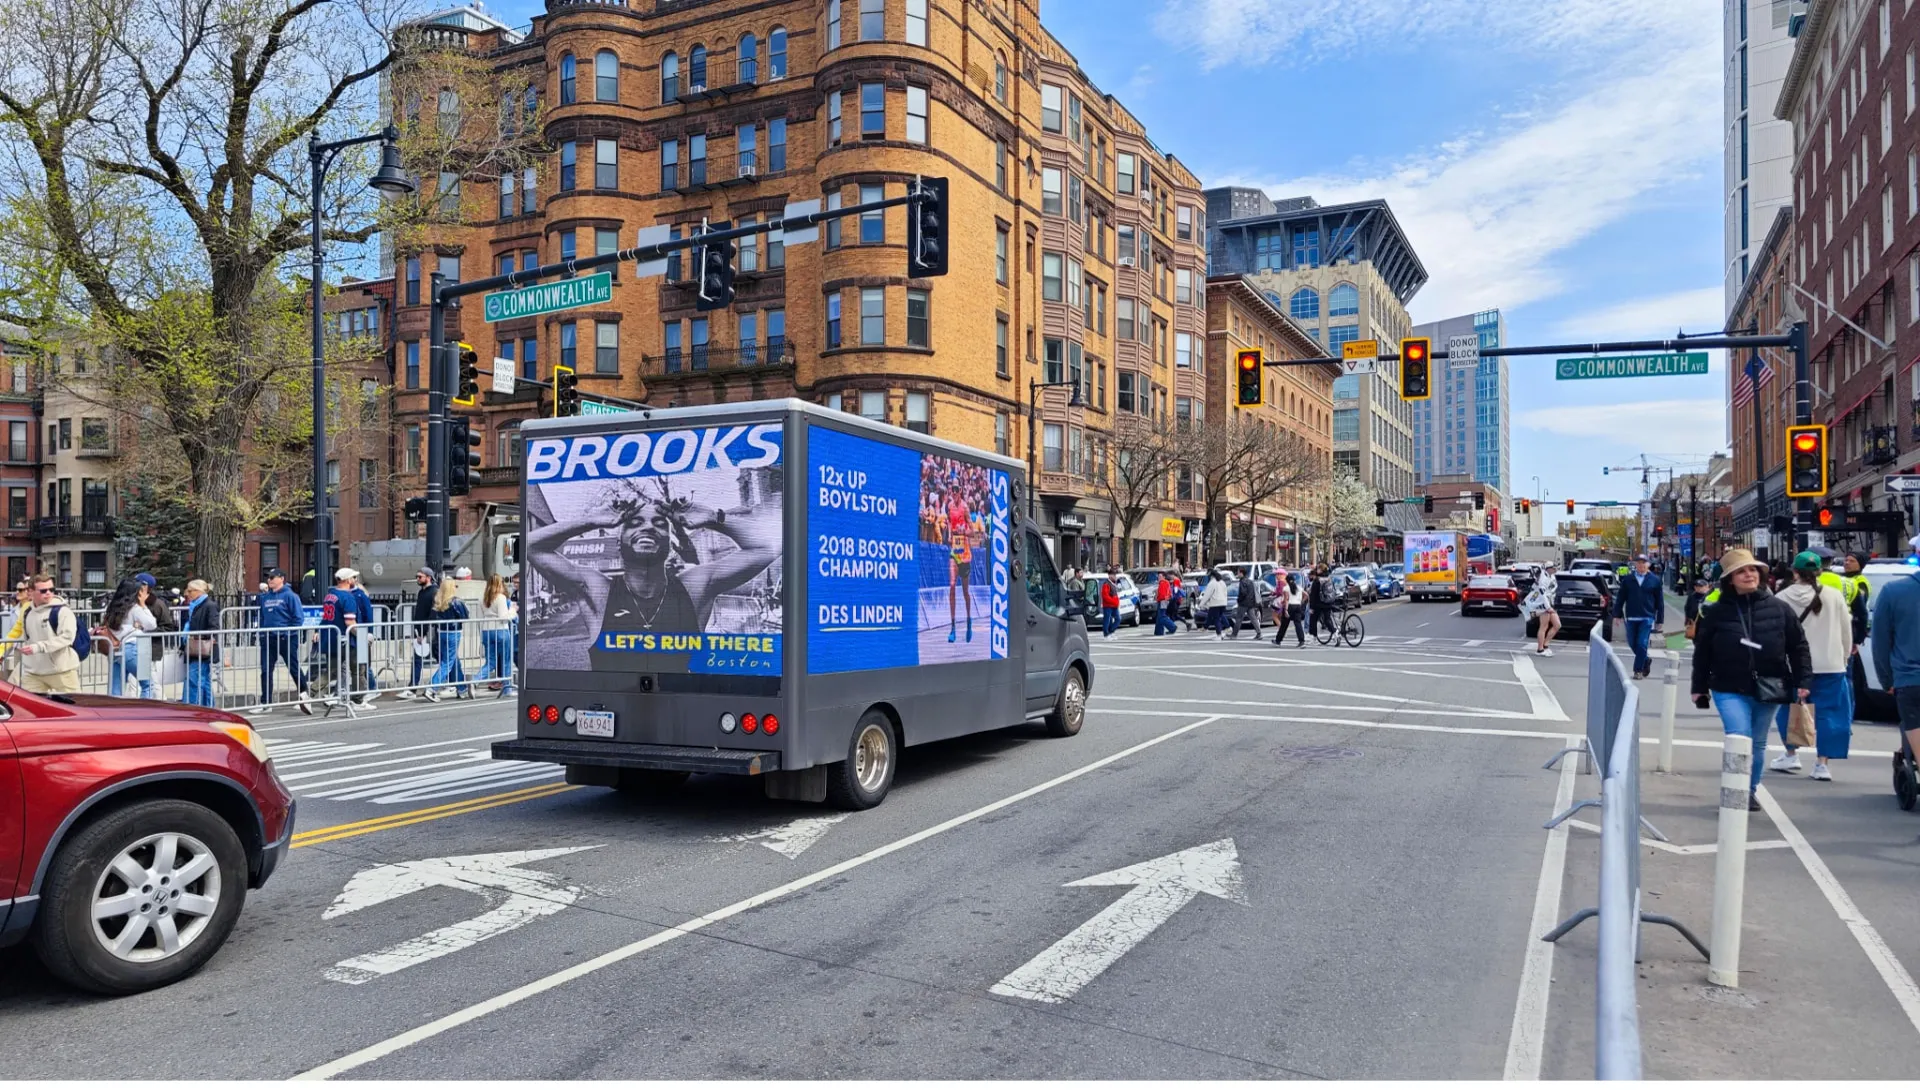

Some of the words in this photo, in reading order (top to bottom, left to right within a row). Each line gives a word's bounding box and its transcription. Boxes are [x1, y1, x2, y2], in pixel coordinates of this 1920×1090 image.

[503, 280, 595, 315] COMMONWEALTH
[597, 286, 609, 299] AVE
[1450, 349, 1477, 359] BLOCK
[1578, 356, 1688, 377] COMMONWEALTH
[1691, 363, 1705, 372] AVE
[495, 372, 514, 384] BLOCK
[528, 423, 783, 480] BROOKS
[848, 471, 867, 490] UP
[819, 487, 897, 516] BOYLSTON
[563, 544, 605, 556] FINISH
[819, 535, 855, 557] 2018
[859, 538, 913, 561] BOSTON
[819, 558, 898, 580] CHAMPION
[992, 469, 1008, 659] BROOKS
[819, 605, 848, 624] DES
[852, 605, 903, 624] LINDEN
[605, 635, 656, 649] LET'S
[661, 635, 702, 650] RUN
[707, 636, 774, 653] THERE
